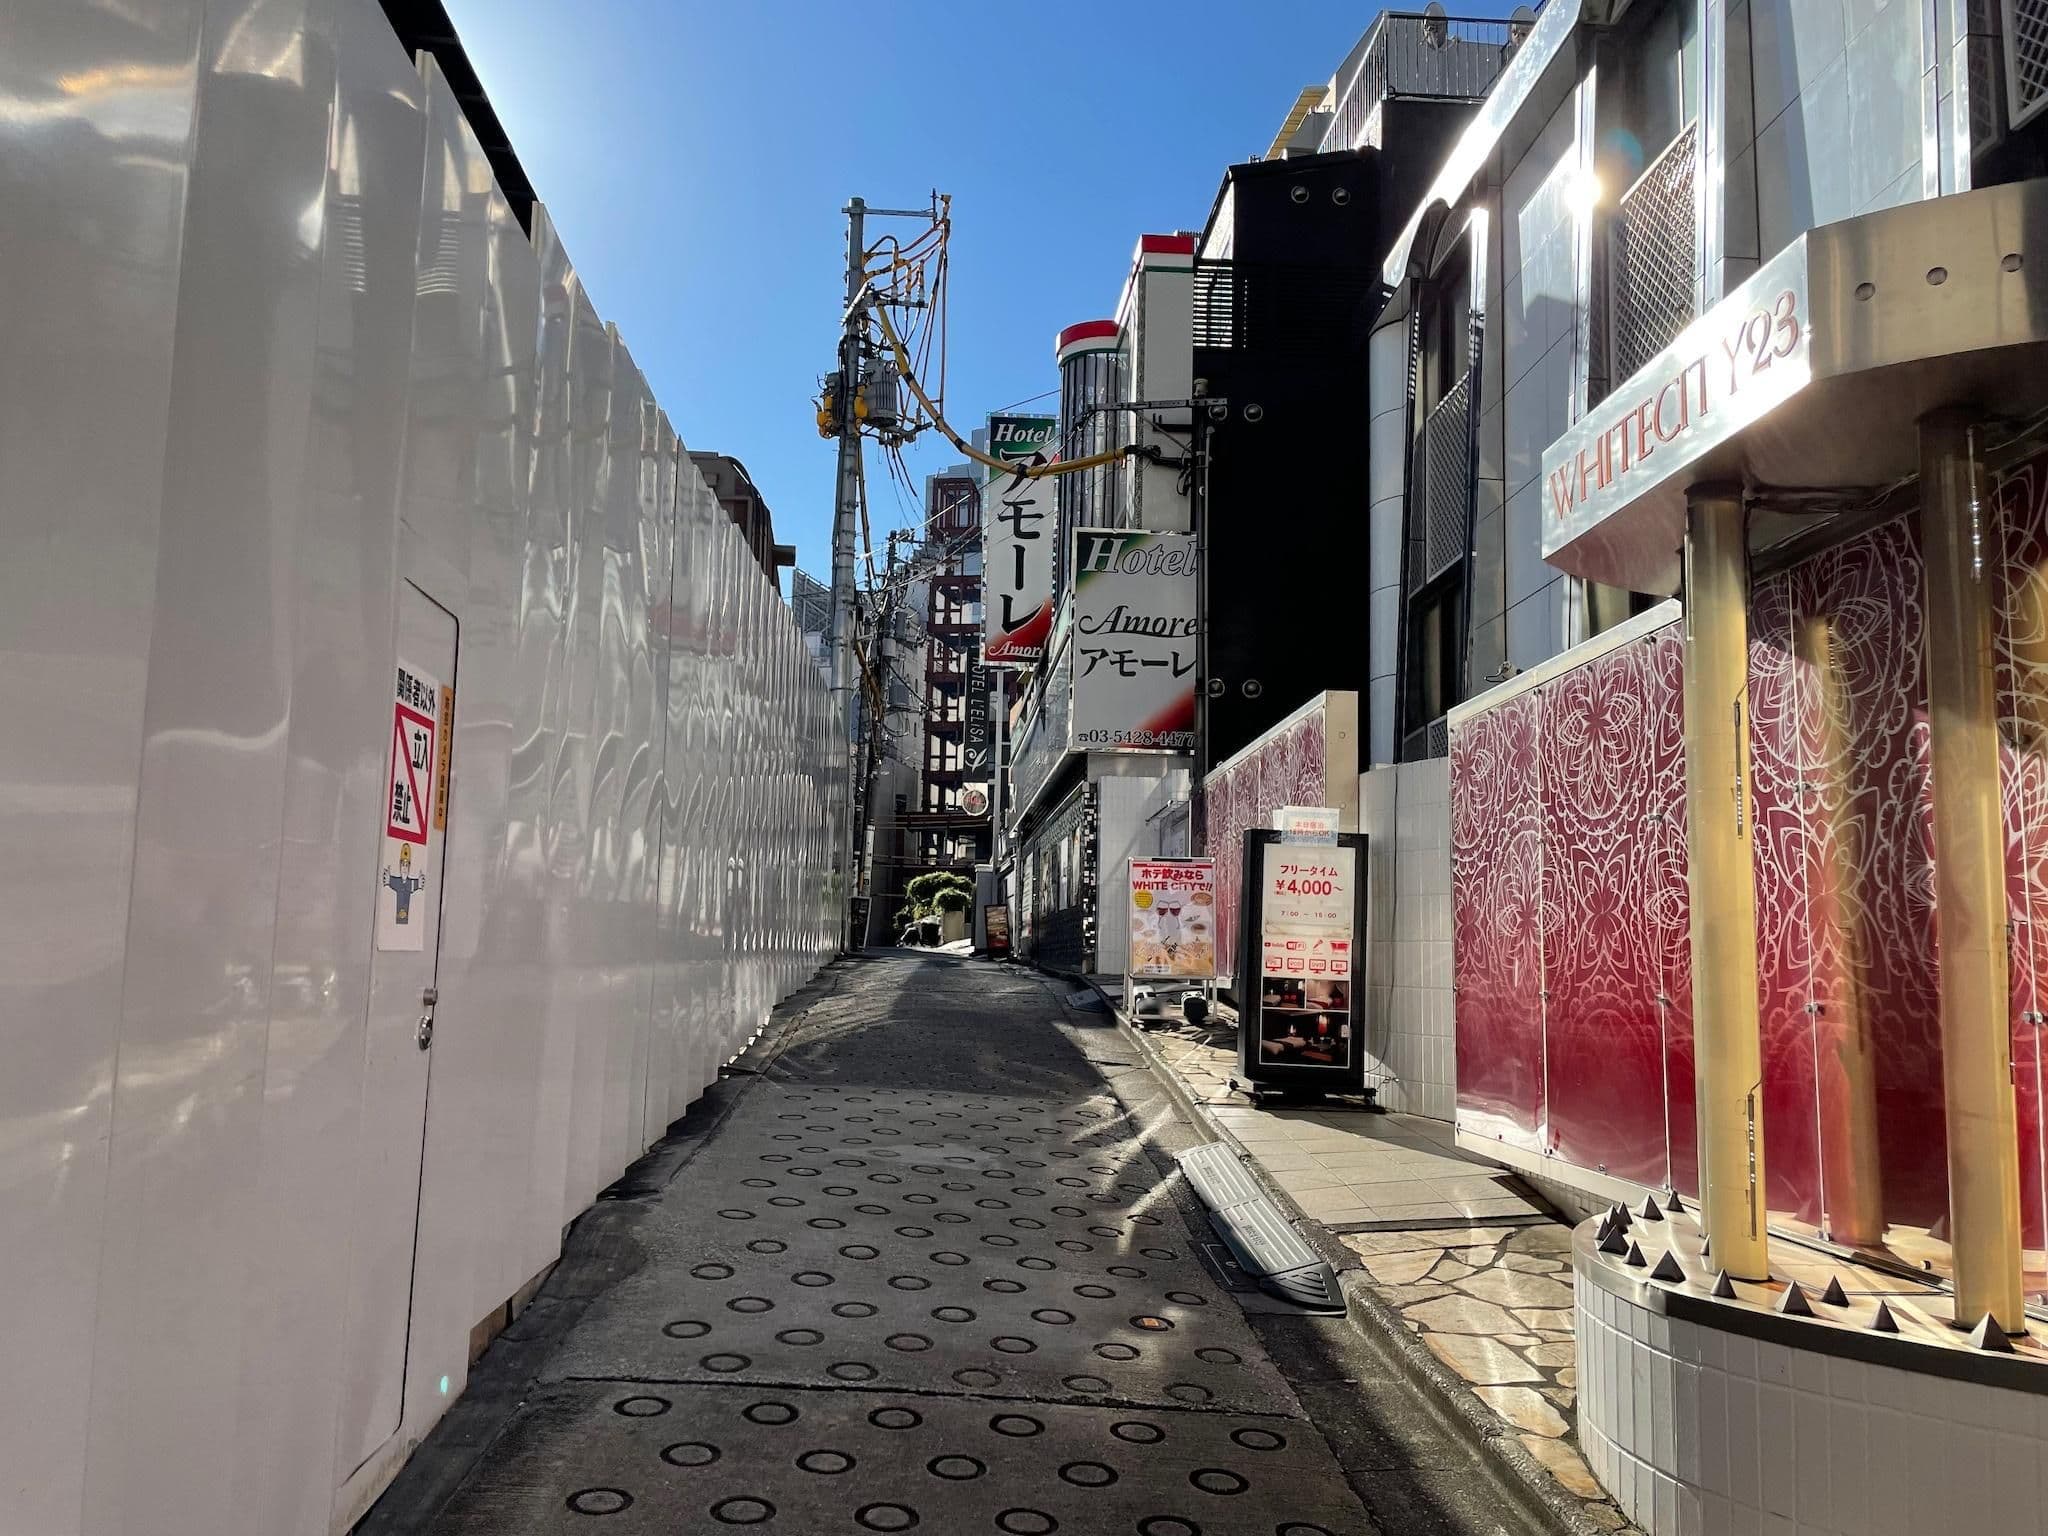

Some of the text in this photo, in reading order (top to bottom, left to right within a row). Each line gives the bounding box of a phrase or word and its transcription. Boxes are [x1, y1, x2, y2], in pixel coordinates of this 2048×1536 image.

[1549, 290, 1799, 520] WHITECITY23
[994, 423, 1053, 443] Hotel
[998, 448, 1047, 636] アモーレ
[1081, 537, 1197, 576] Hotel
[1079, 605, 1197, 638] Amore
[1080, 648, 1197, 678] アモーレ
[398, 667, 436, 716] 関係者以外
[411, 729, 429, 773] 立入
[392, 780, 411, 825] 禁止
[1133, 881, 1169, 890] WHITE
[1142, 868, 1204, 881] ホテ飲みなら
[1280, 865, 1338, 877] フリータイム
